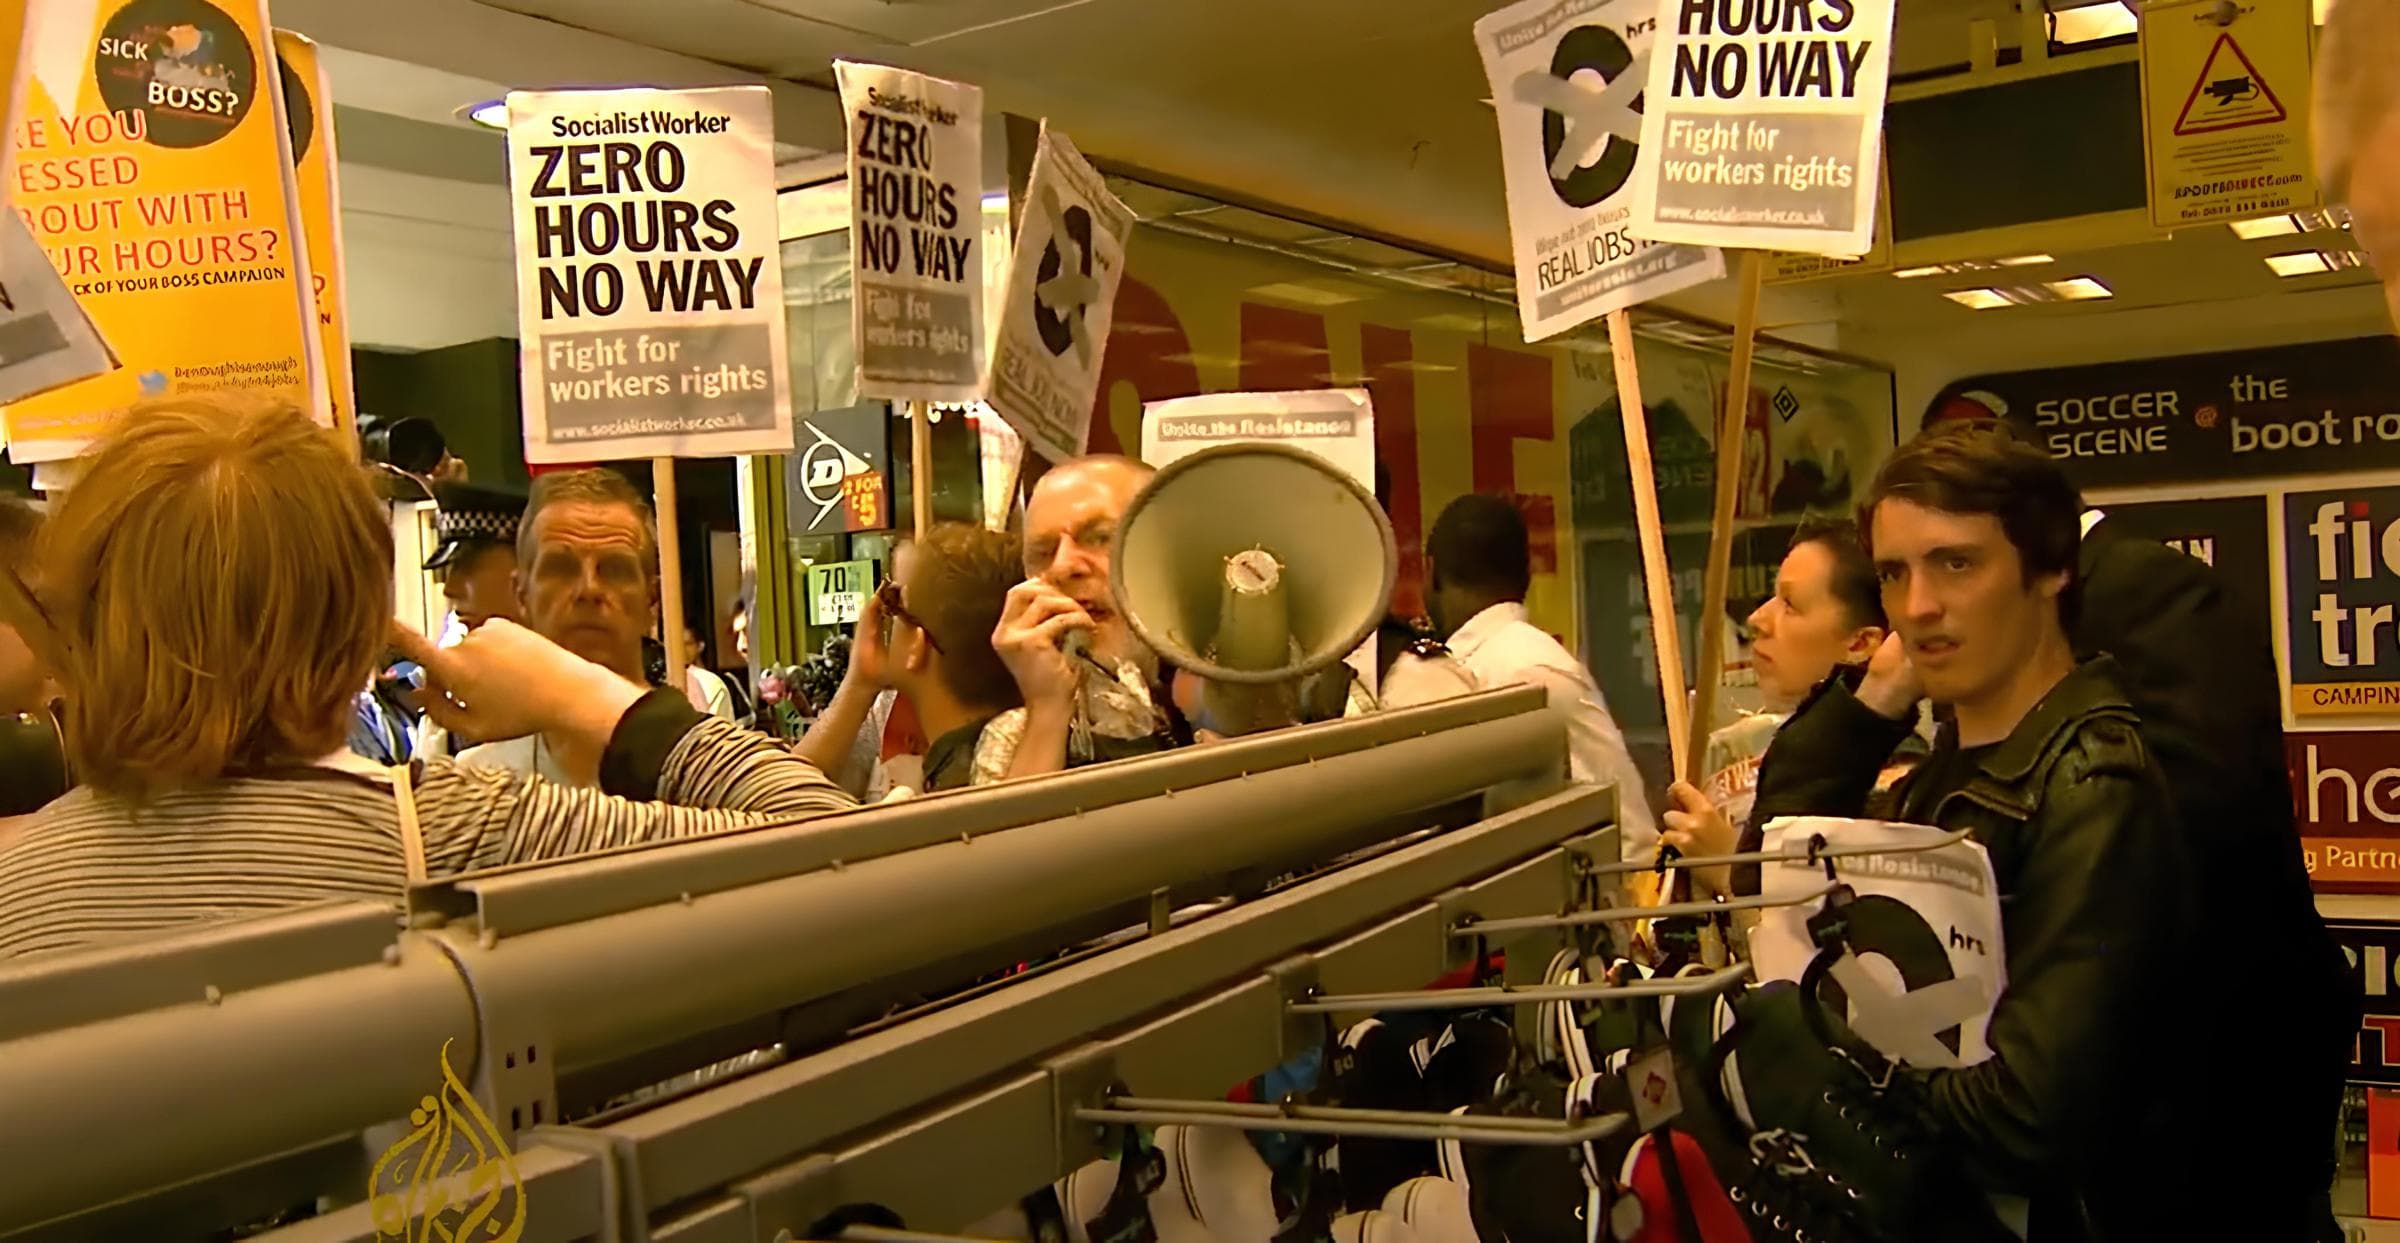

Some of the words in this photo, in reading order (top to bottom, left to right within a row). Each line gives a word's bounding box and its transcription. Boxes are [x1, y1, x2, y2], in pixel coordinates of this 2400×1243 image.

[1625, 17, 1656, 38] hrs
[1679, 0, 1854, 36] HOURS
[100, 37, 149, 61] SICK
[1671, 43, 1748, 99] NO
[1759, 41, 1872, 97] WAY
[148, 80, 239, 115] BOSS?
[16, 119, 47, 149] E
[60, 108, 148, 146] YOU
[858, 110, 932, 171] ZERO
[1668, 120, 1740, 156] Fight
[1747, 120, 1780, 151] for
[530, 141, 686, 198] ZERO
[1665, 155, 1764, 185] workers
[1773, 155, 1852, 191] rights
[137, 190, 248, 226] WITH
[861, 166, 958, 230] HOURS
[535, 199, 740, 258] HOURS
[115, 230, 279, 271] HOURS?
[861, 219, 900, 274] NO
[910, 227, 972, 283] WAY
[1538, 245, 1585, 291] REAL
[1585, 225, 1636, 271] JOBS
[116, 275, 158, 292] YOUR
[162, 273, 200, 289] BOSS
[539, 263, 624, 320] NO
[637, 257, 764, 314] WAY
[546, 337, 627, 373] Fight
[637, 340, 680, 364] for
[549, 371, 671, 402] workers
[680, 364, 768, 398] rights
[2230, 375, 2288, 402] the
[2036, 391, 2180, 427] SOCCER
[2195, 406, 2219, 429] @
[2049, 425, 2168, 459] SCENE
[2231, 410, 2342, 453] boot
[2312, 593, 2400, 667] tr
[2313, 685, 2400, 706] CAMPIN
[2326, 845, 2400, 870] Partn
